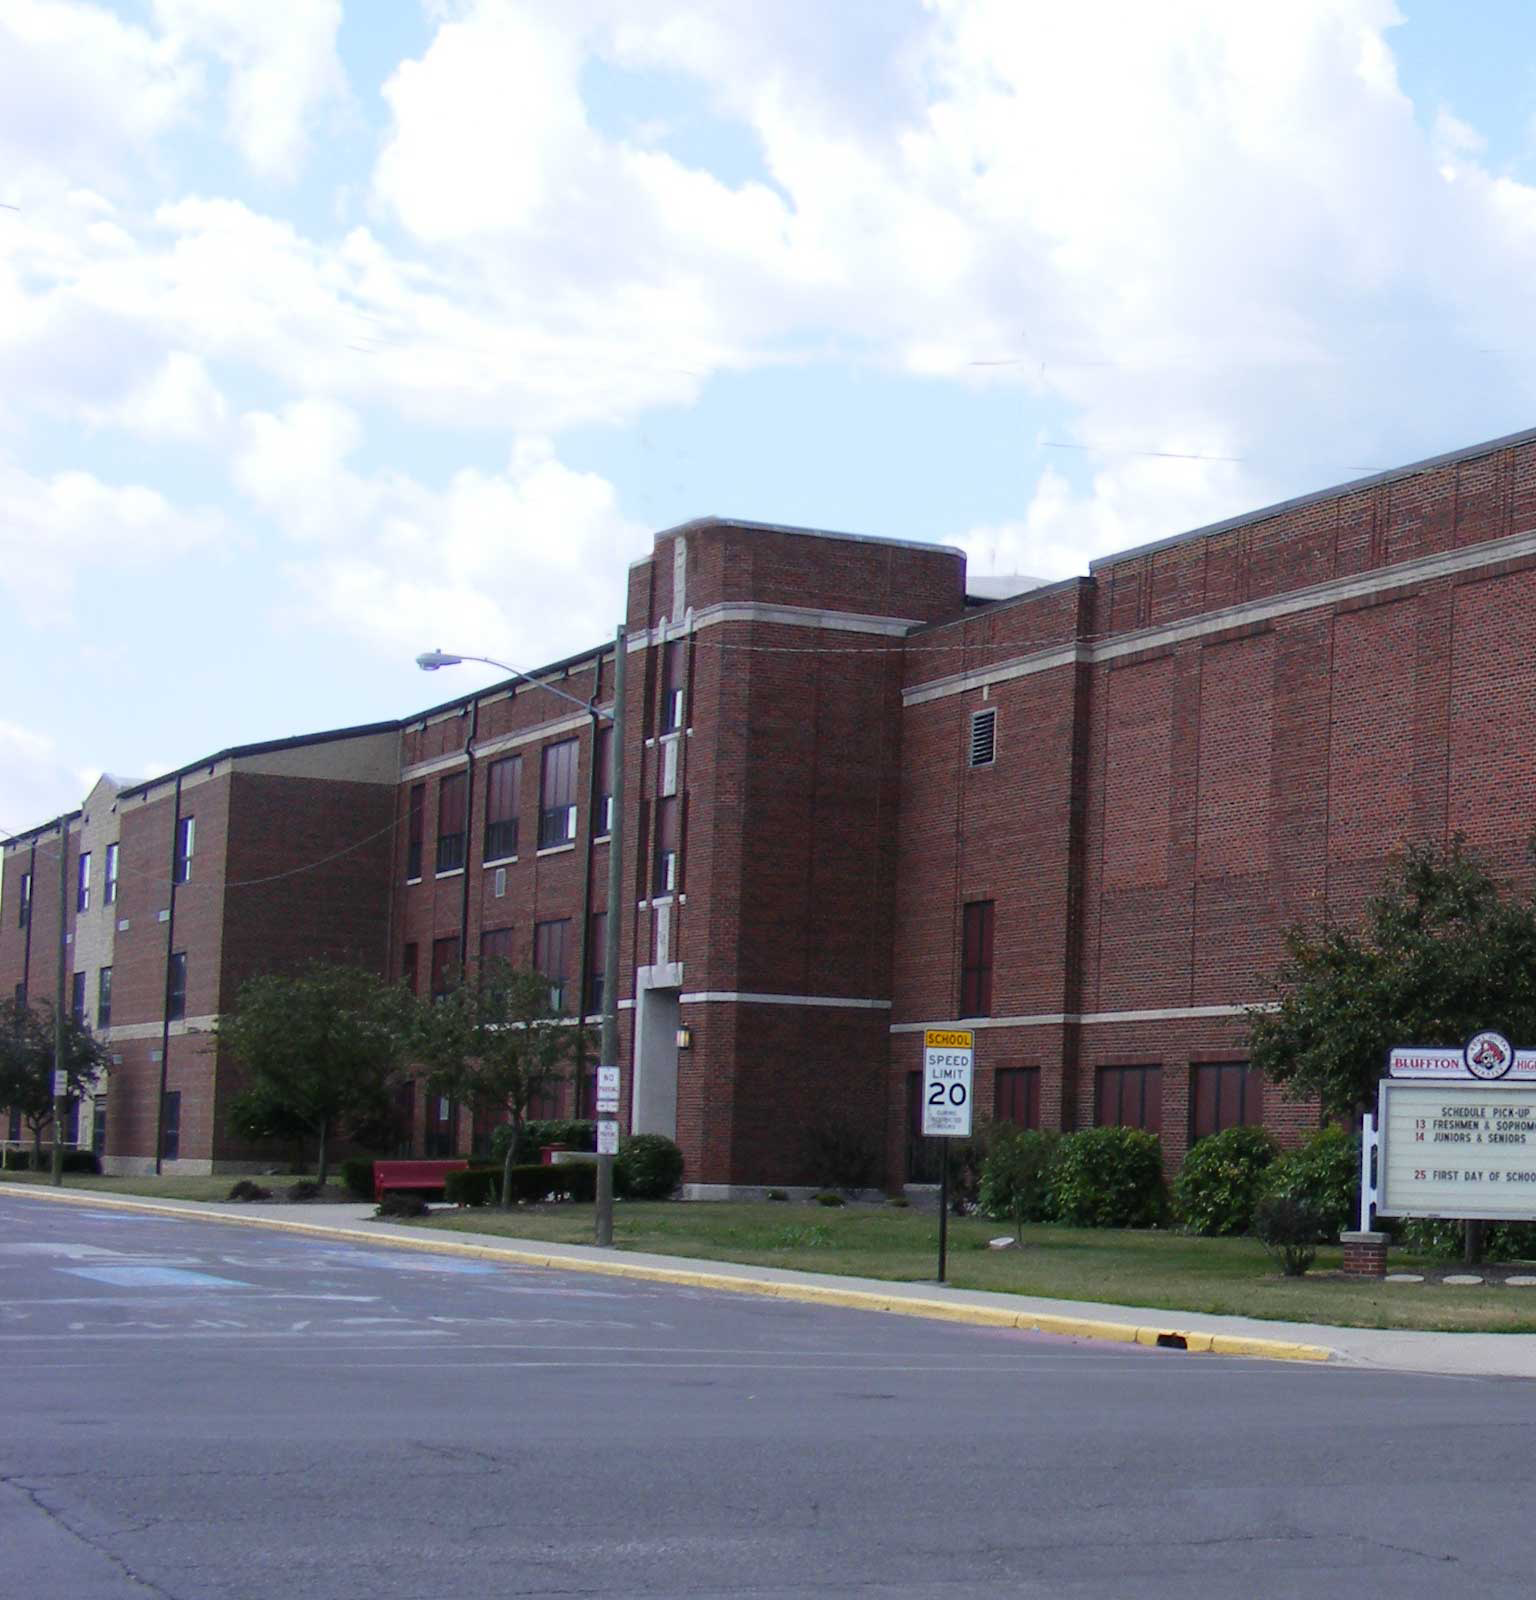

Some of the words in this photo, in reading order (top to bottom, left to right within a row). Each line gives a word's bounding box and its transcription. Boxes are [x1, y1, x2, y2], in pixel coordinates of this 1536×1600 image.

[928, 1033, 970, 1046] SCHOOL
[929, 1055, 969, 1066] SPEED
[1395, 1058, 1460, 1069] BLUFFTON
[603, 1073, 615, 1082] NO
[932, 1068, 964, 1079] LIMIT
[928, 1082, 967, 1106] 20
[1441, 1107, 1486, 1118] SCHEDULE
[1492, 1107, 1530, 1119] PICK-UP
[1415, 1119, 1426, 1130] 13
[1433, 1119, 1479, 1131] FRESHMEN
[1484, 1120, 1491, 1131] &
[1415, 1132, 1425, 1142] 14
[1433, 1132, 1471, 1143] JUNIORS
[1476, 1133, 1483, 1144] &
[1488, 1133, 1526, 1144] SENIORS
[1414, 1169, 1427, 1180] 25
[1433, 1170, 1459, 1181] FIRST
[1464, 1170, 1484, 1182] DAY
[1489, 1171, 1500, 1182] OF
